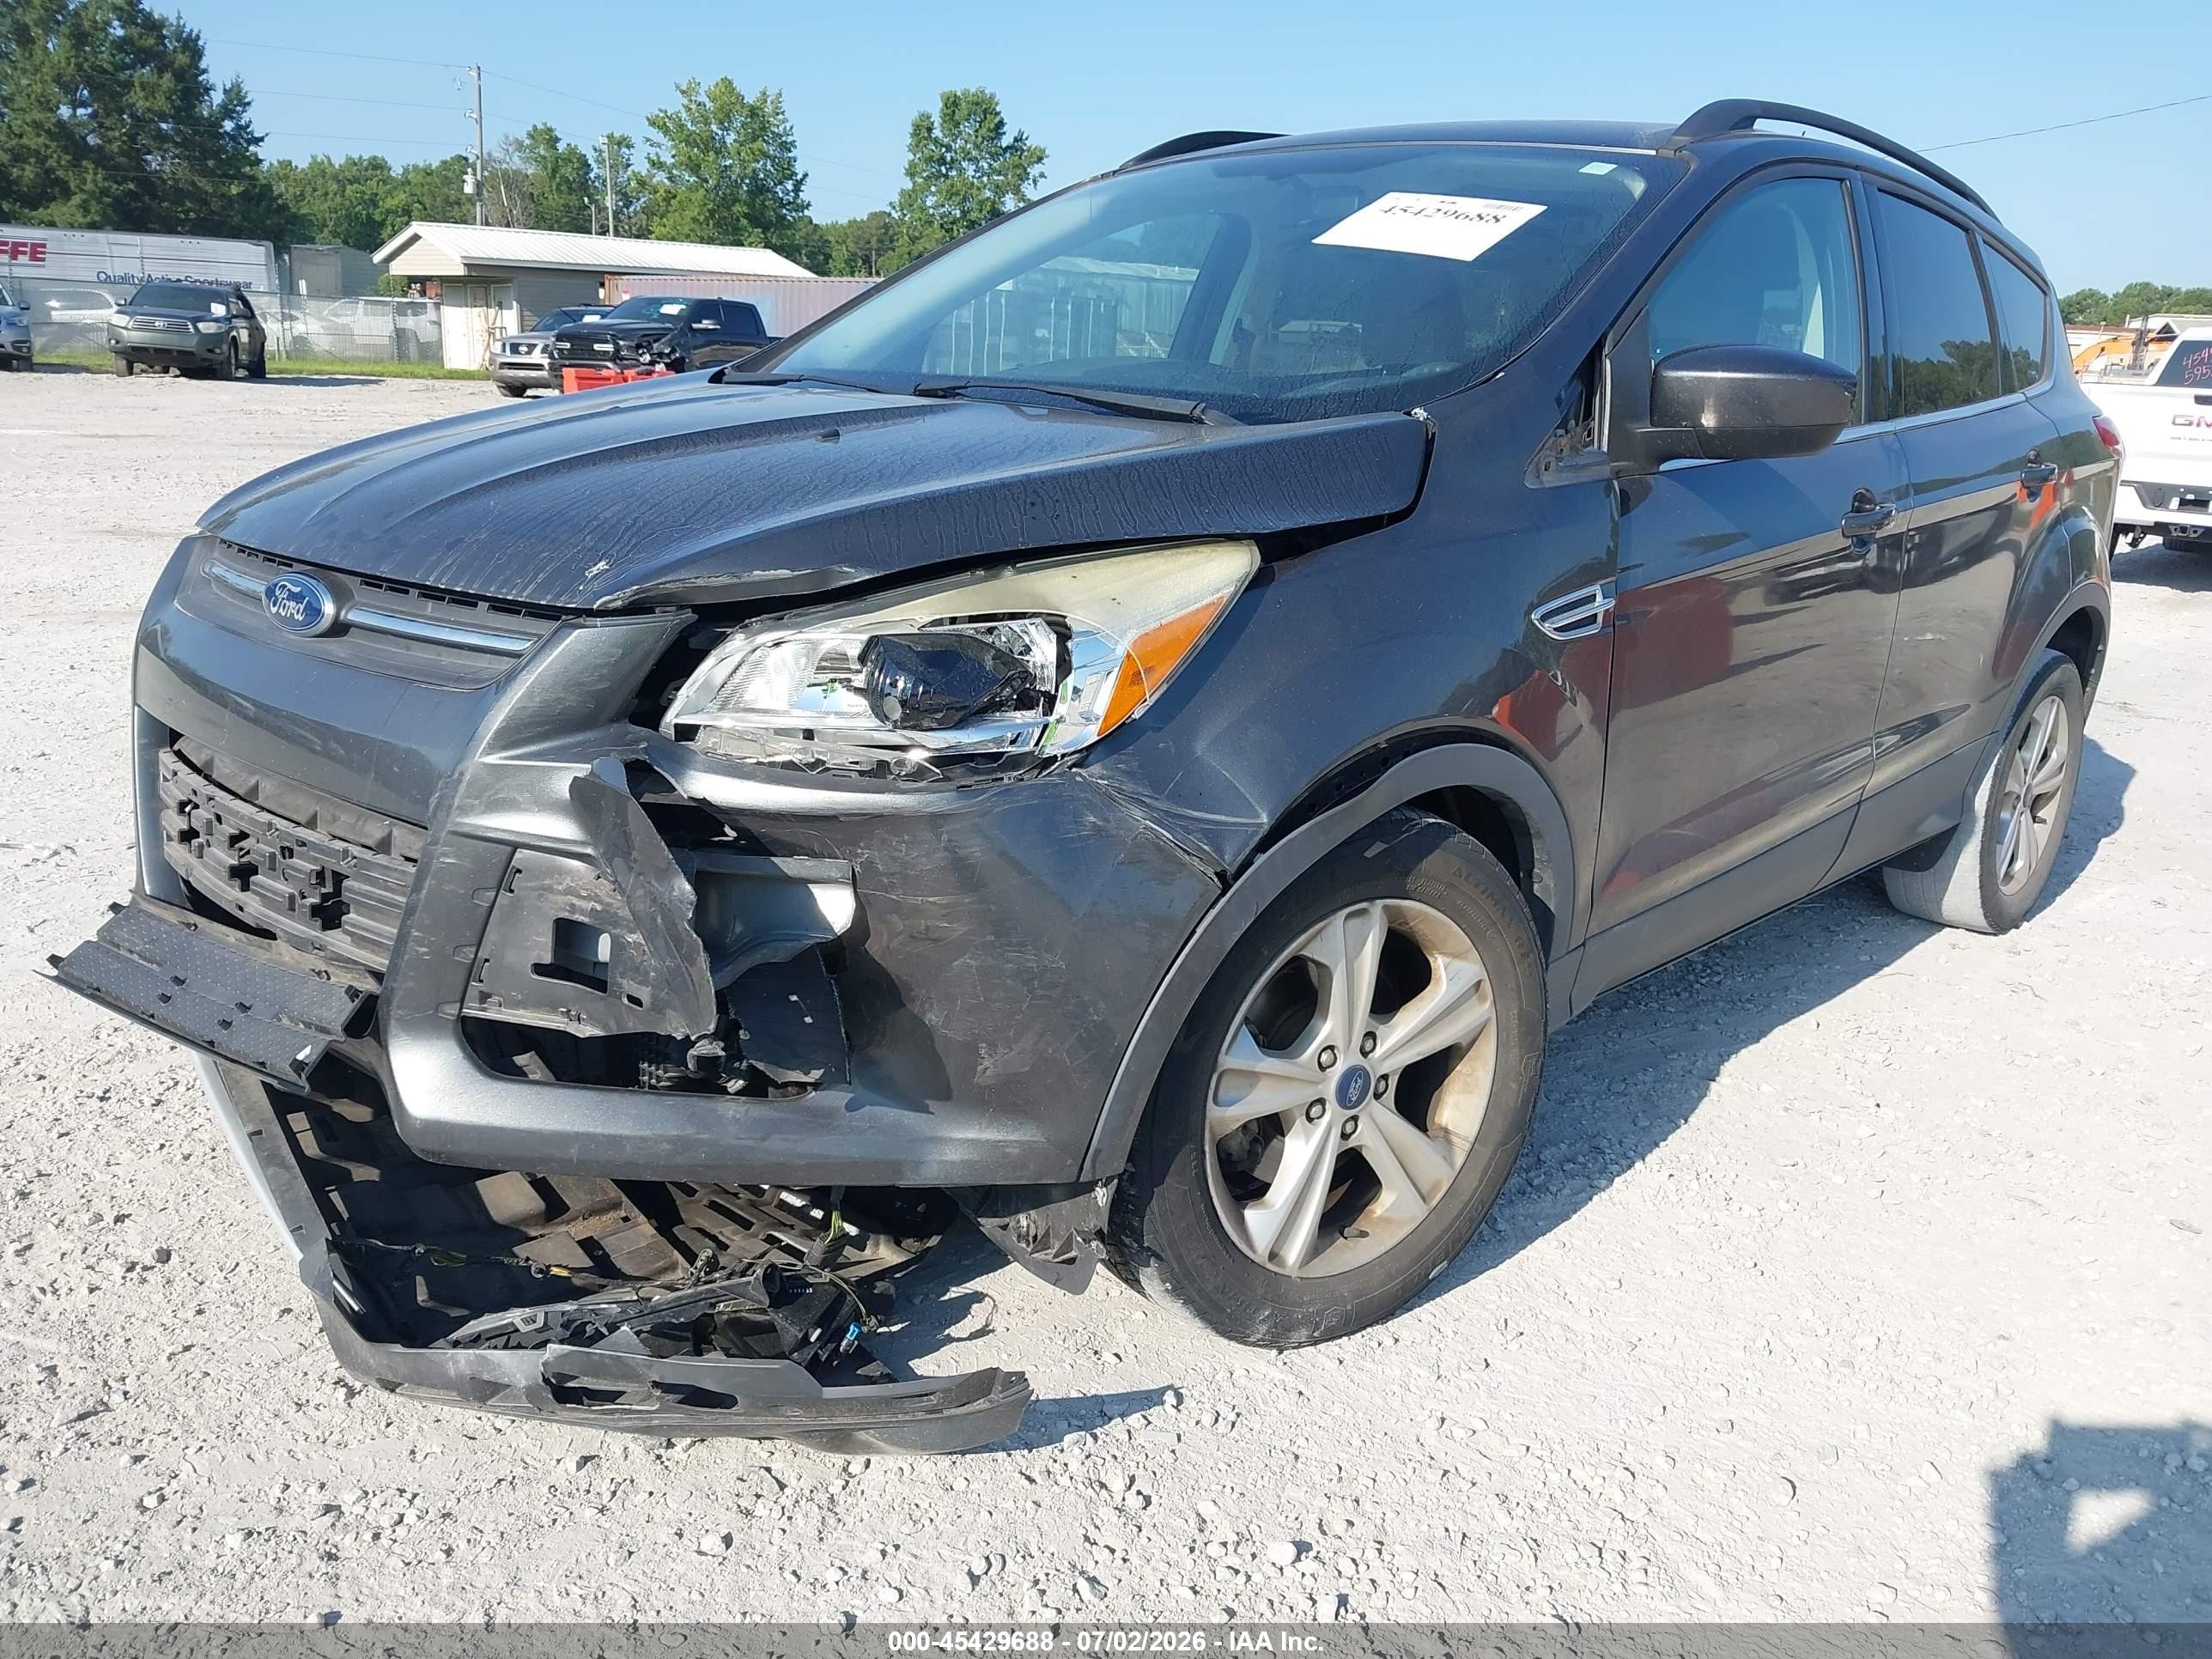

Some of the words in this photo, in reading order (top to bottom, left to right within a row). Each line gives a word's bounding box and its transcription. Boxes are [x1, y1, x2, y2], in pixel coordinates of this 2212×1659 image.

[97, 270, 144, 284] Quality
[146, 273, 181, 284] Acti
[2183, 347, 2212, 368] 454
[2184, 365, 2212, 385] 595
[270, 581, 309, 621] Ford
